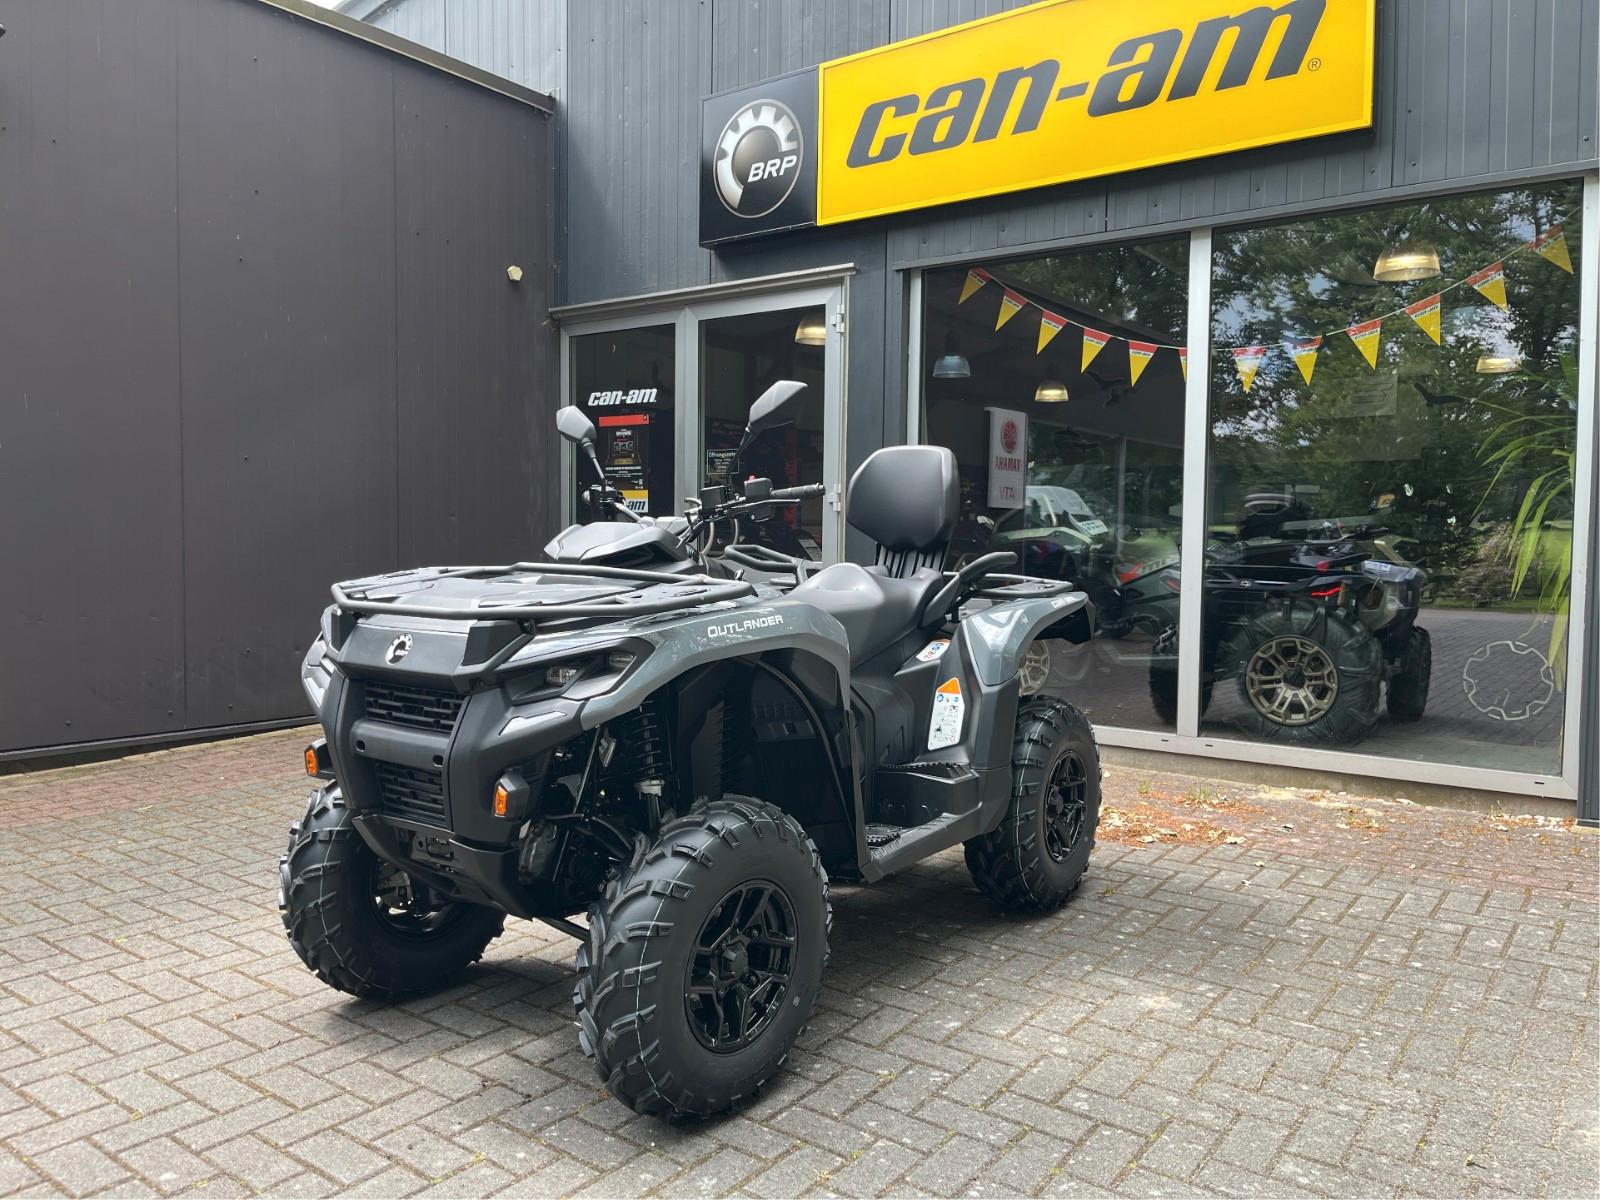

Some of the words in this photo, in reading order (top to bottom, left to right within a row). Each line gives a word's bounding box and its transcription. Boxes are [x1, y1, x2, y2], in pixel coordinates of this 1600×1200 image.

[846, 0, 1327, 168] can-am
[747, 155, 797, 183] BRP
[587, 388, 658, 407] can-am
[707, 615, 784, 638] OUTLANDER
